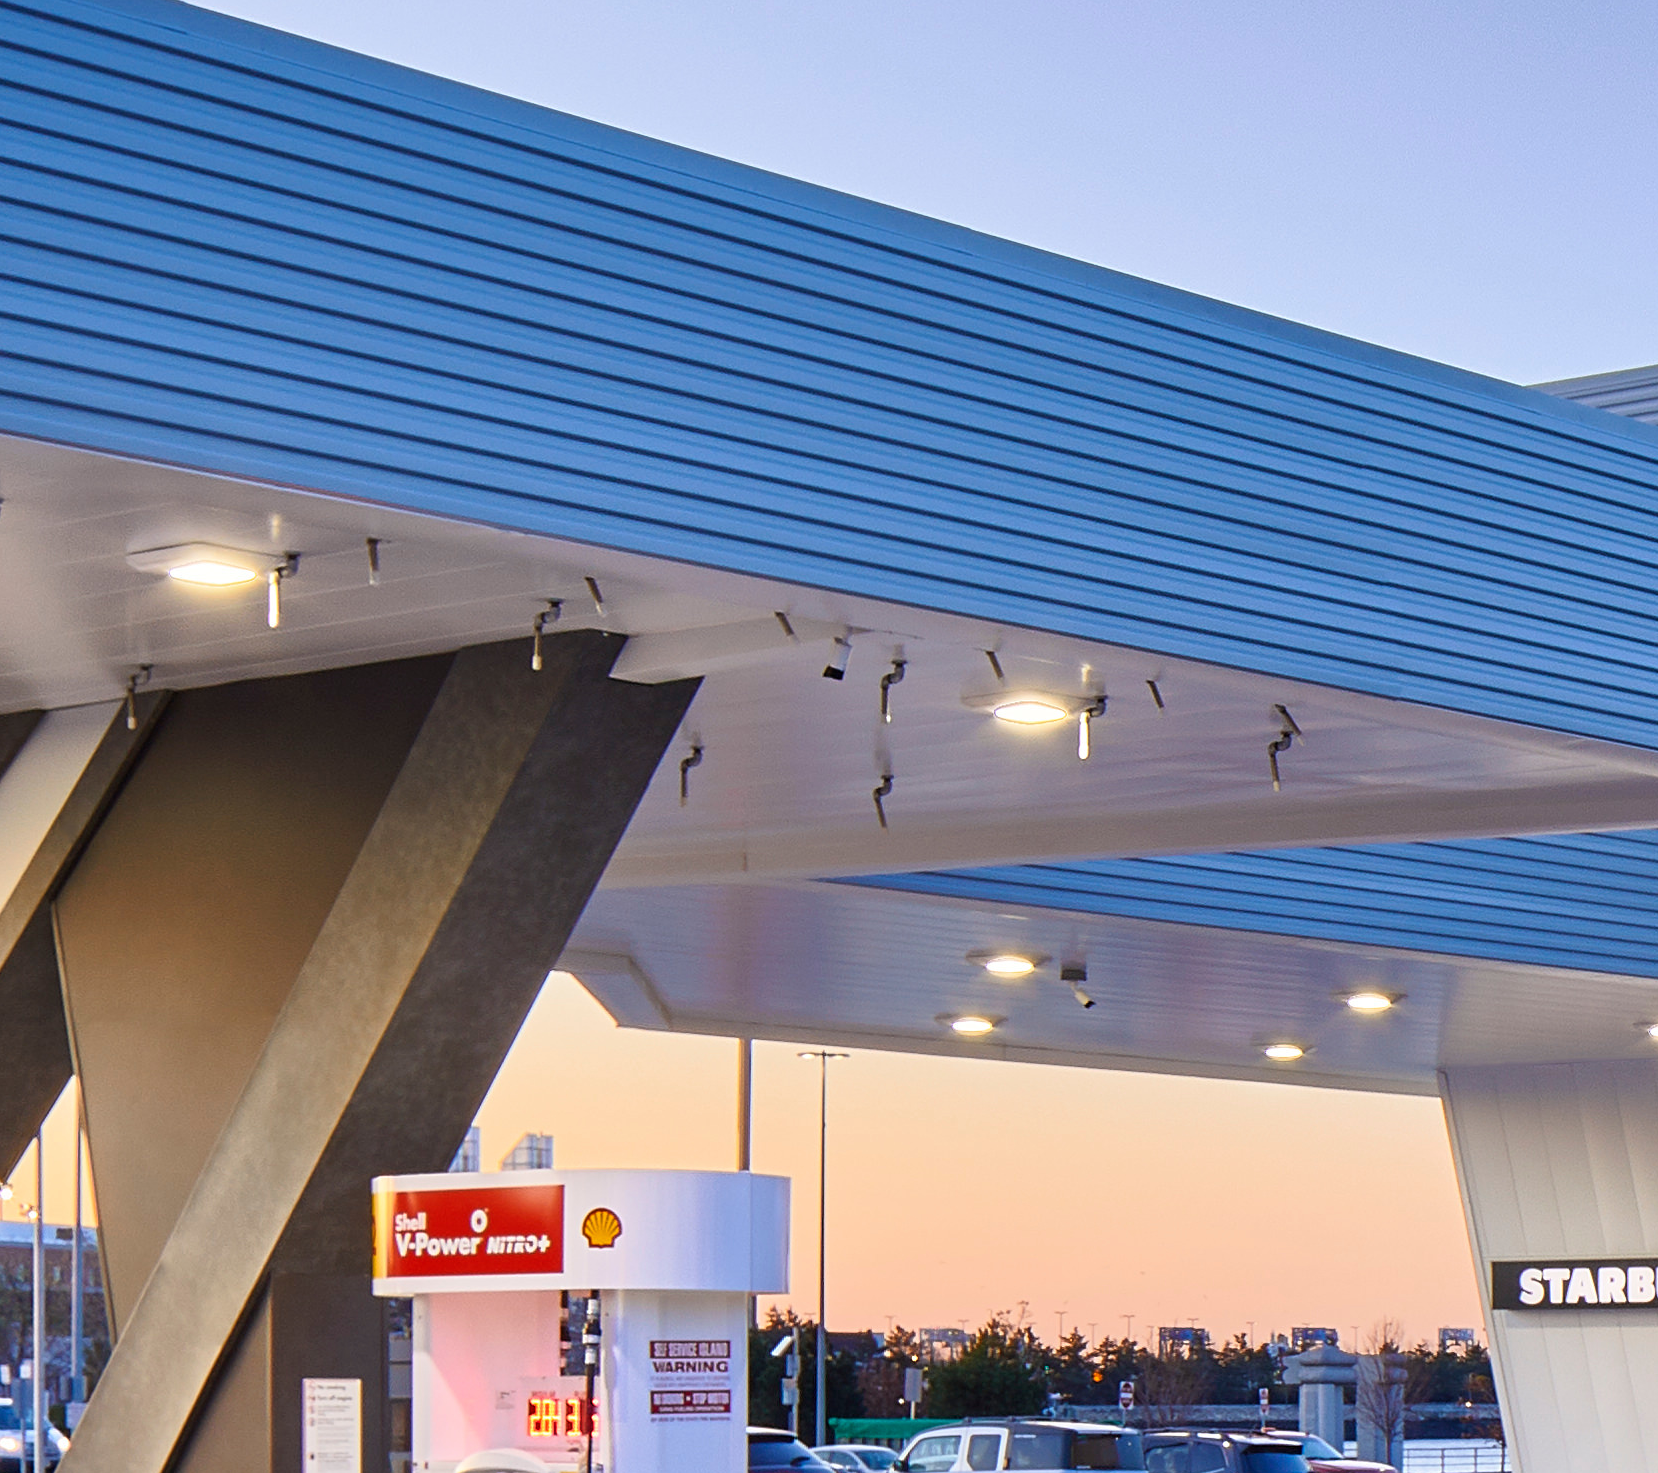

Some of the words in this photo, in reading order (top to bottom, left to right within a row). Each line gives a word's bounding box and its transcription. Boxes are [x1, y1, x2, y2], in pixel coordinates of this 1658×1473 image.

[395, 1211, 427, 1232] Shell
[395, 1231, 482, 1257] V-Power
[652, 1360, 729, 1374] WARNING
